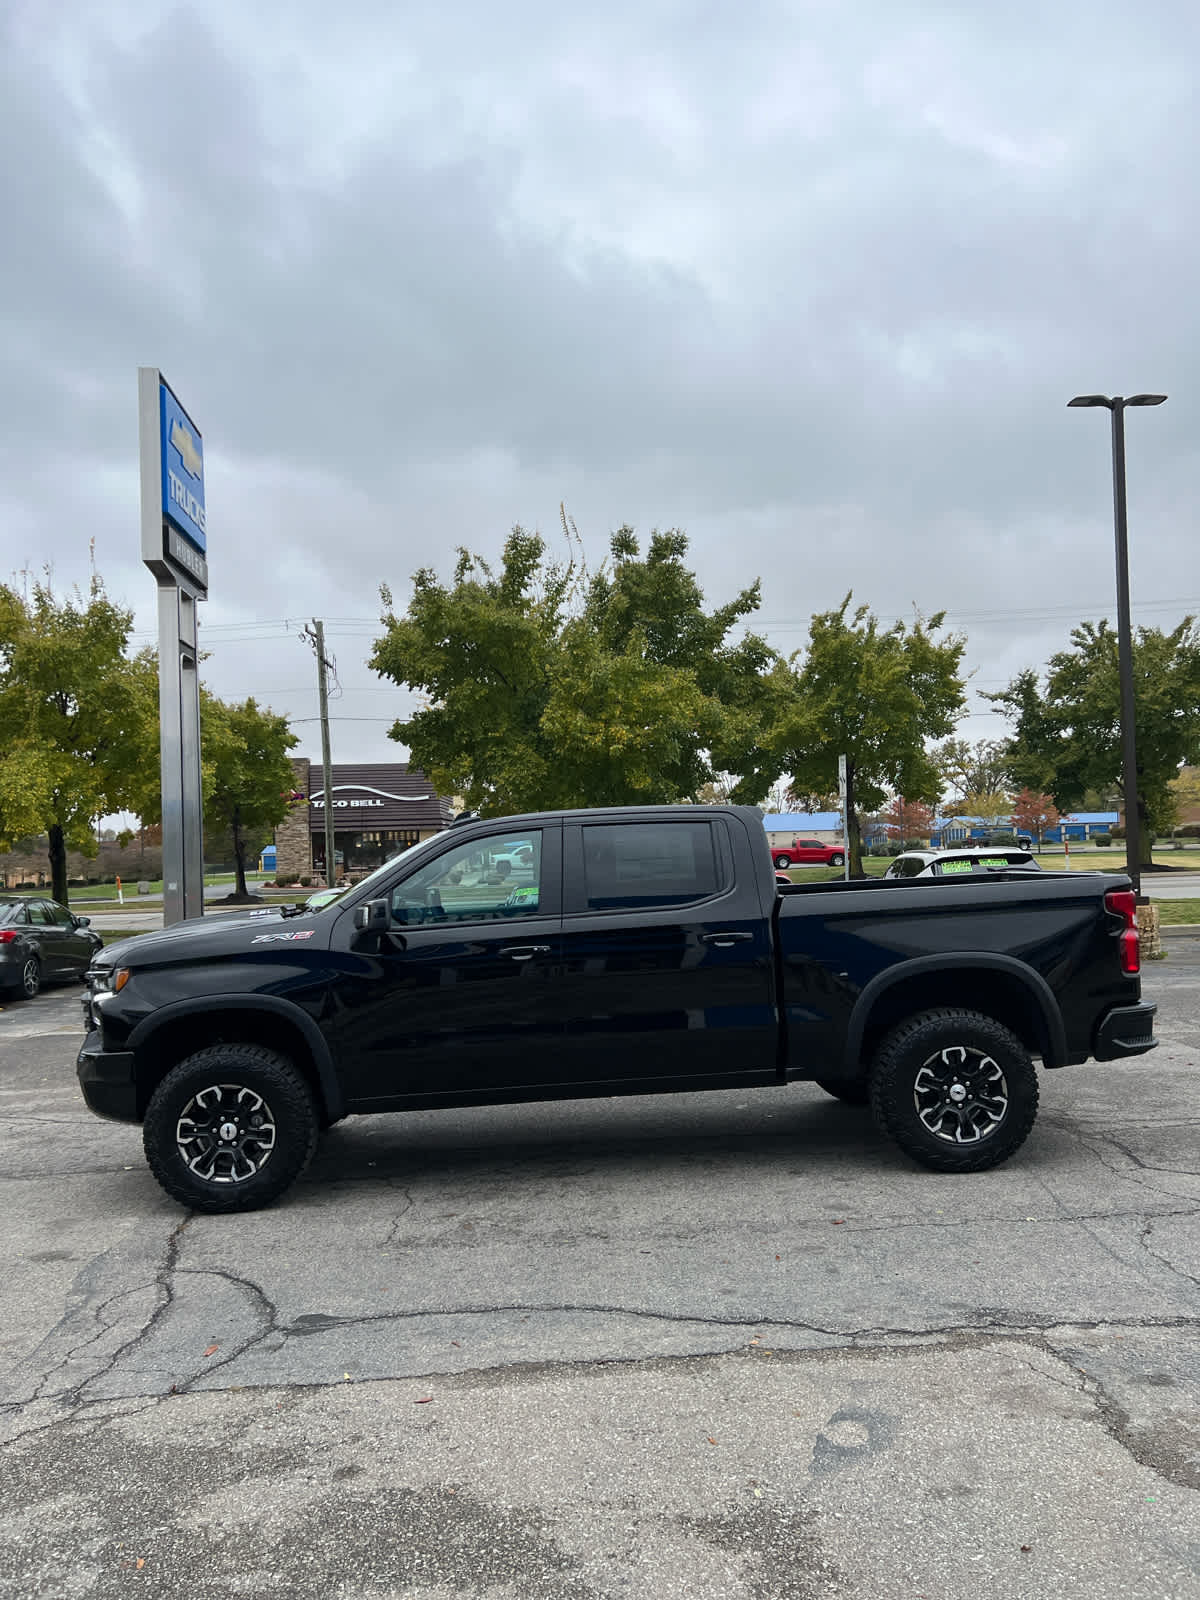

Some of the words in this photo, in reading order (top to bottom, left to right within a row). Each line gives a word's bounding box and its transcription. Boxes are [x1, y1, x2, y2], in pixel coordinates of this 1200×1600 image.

[168, 469, 207, 535] TRUCKS
[312, 800, 348, 808] TACO
[251, 930, 315, 944] ZR2
